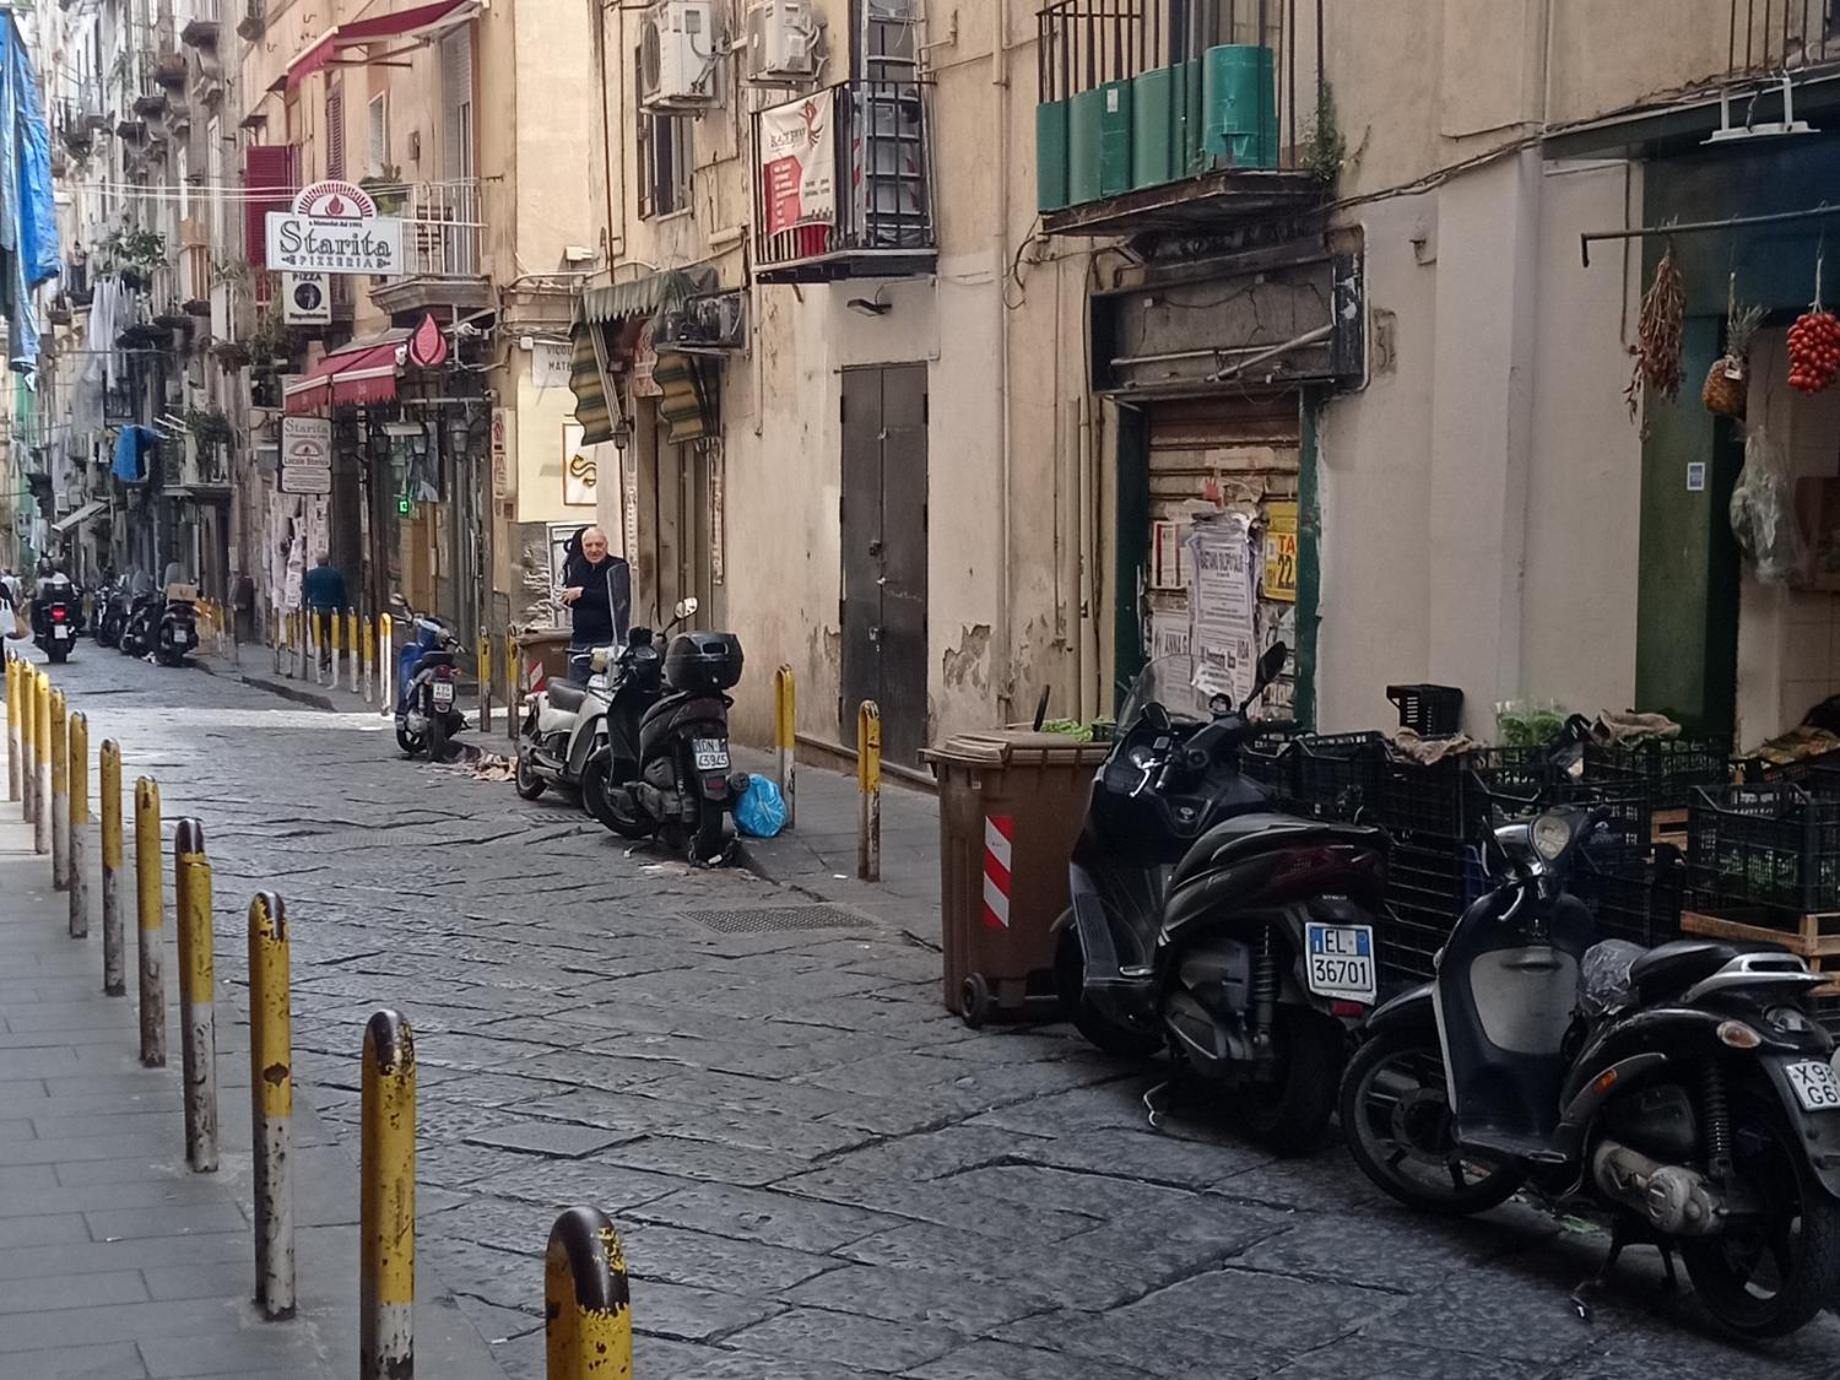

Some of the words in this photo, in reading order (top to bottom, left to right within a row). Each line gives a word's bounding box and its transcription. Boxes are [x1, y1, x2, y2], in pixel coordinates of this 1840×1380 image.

[280, 220, 392, 257] Starita
[300, 255, 373, 268] PIZZERIA
[1325, 930, 1347, 954] EL
[1314, 958, 1367, 985] 36701
